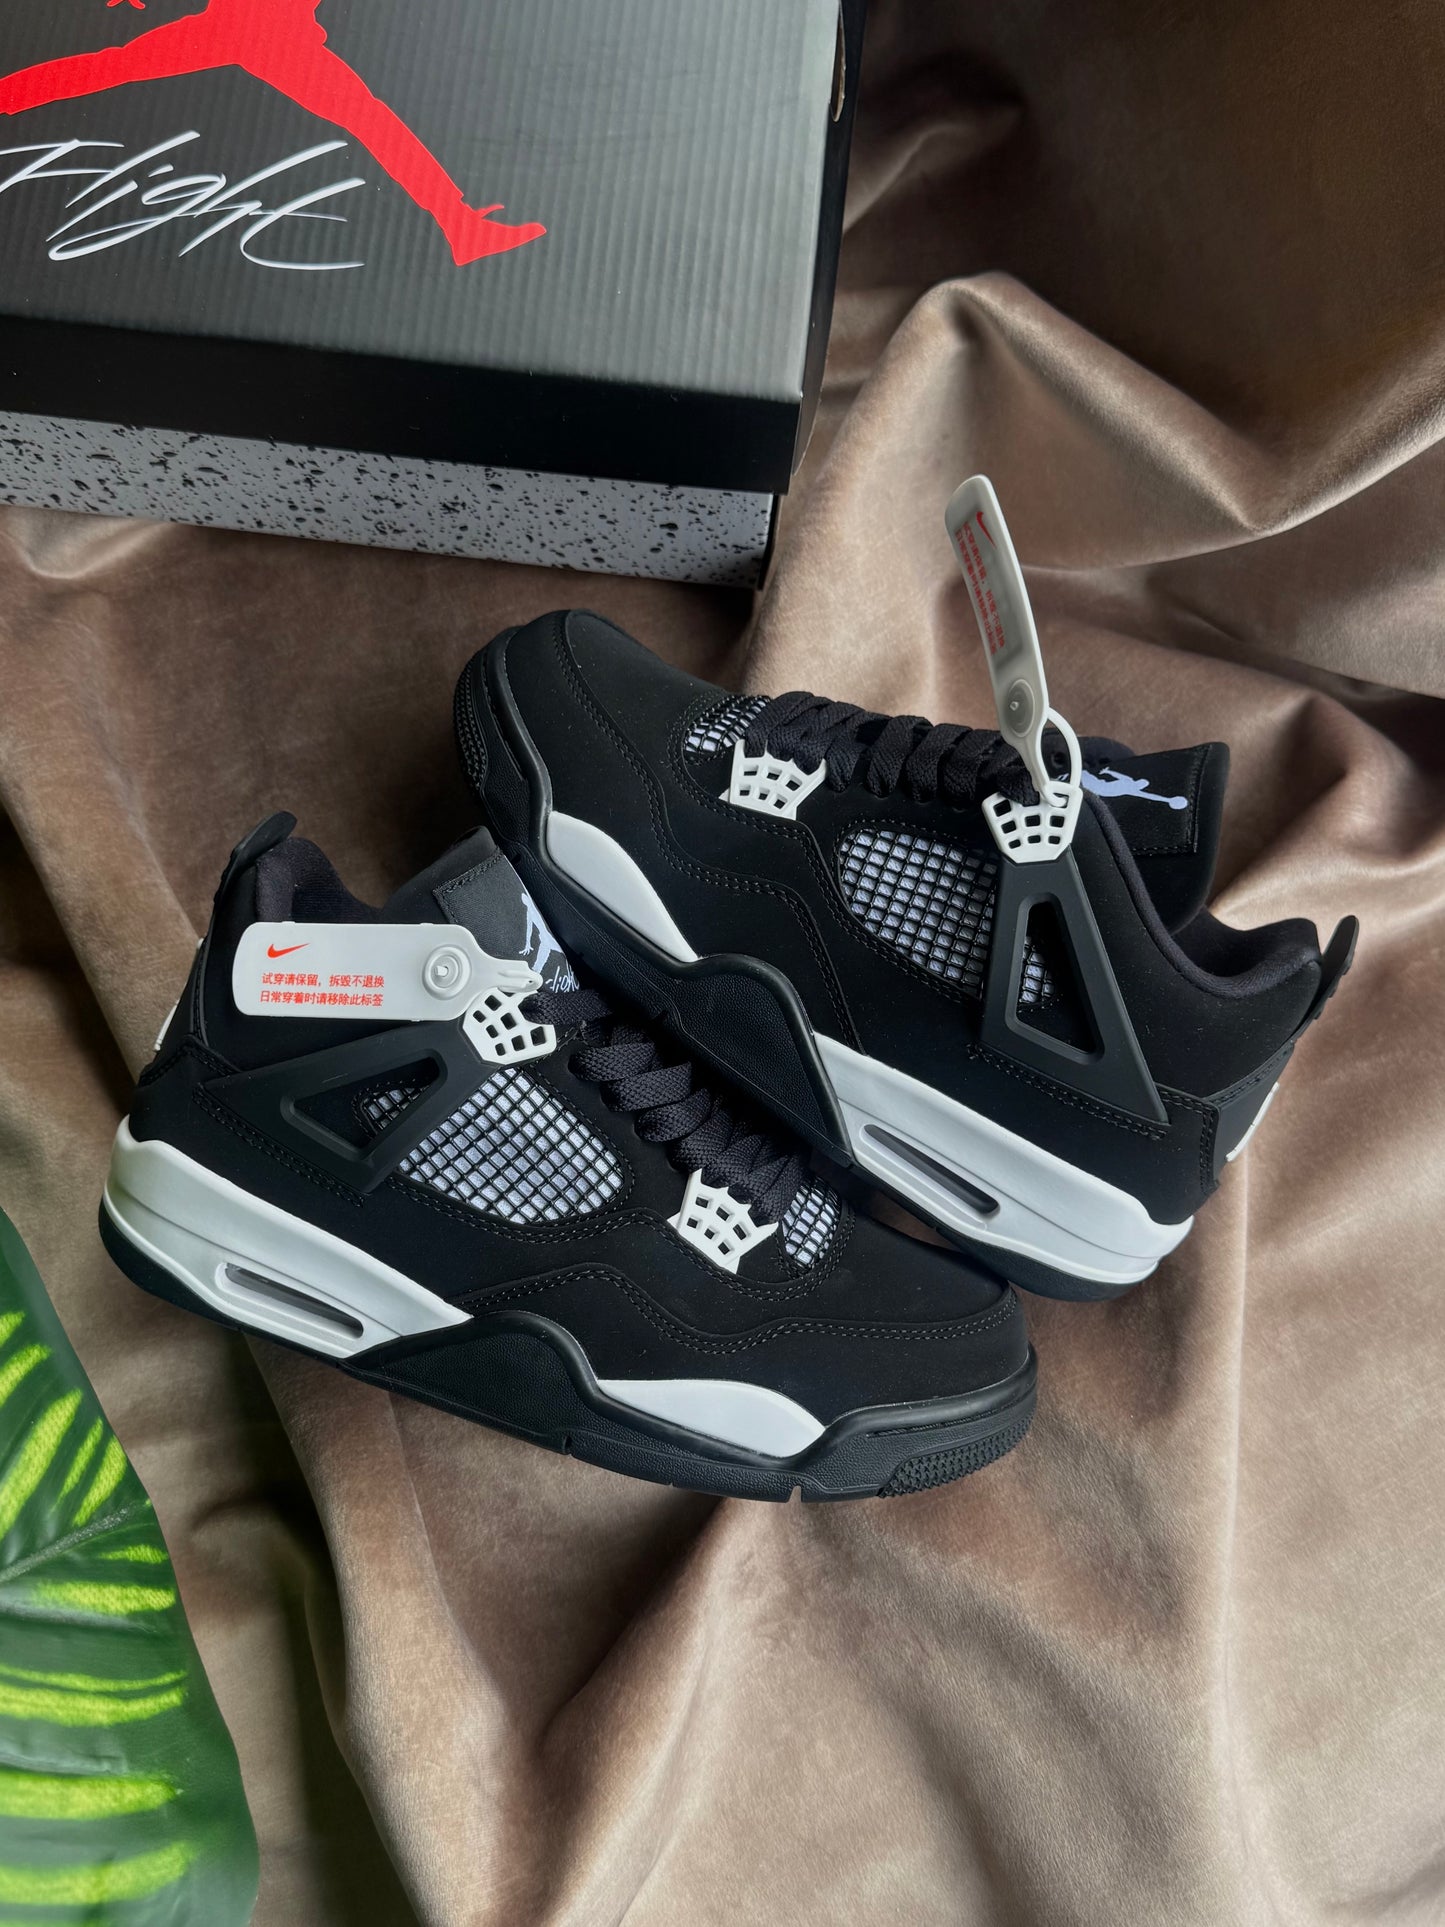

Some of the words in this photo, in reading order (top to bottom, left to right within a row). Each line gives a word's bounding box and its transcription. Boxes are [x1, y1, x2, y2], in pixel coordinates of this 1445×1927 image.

[0, 130, 366, 271] Flight
[260, 989, 384, 1007] 日常穿着时请移除此标签
